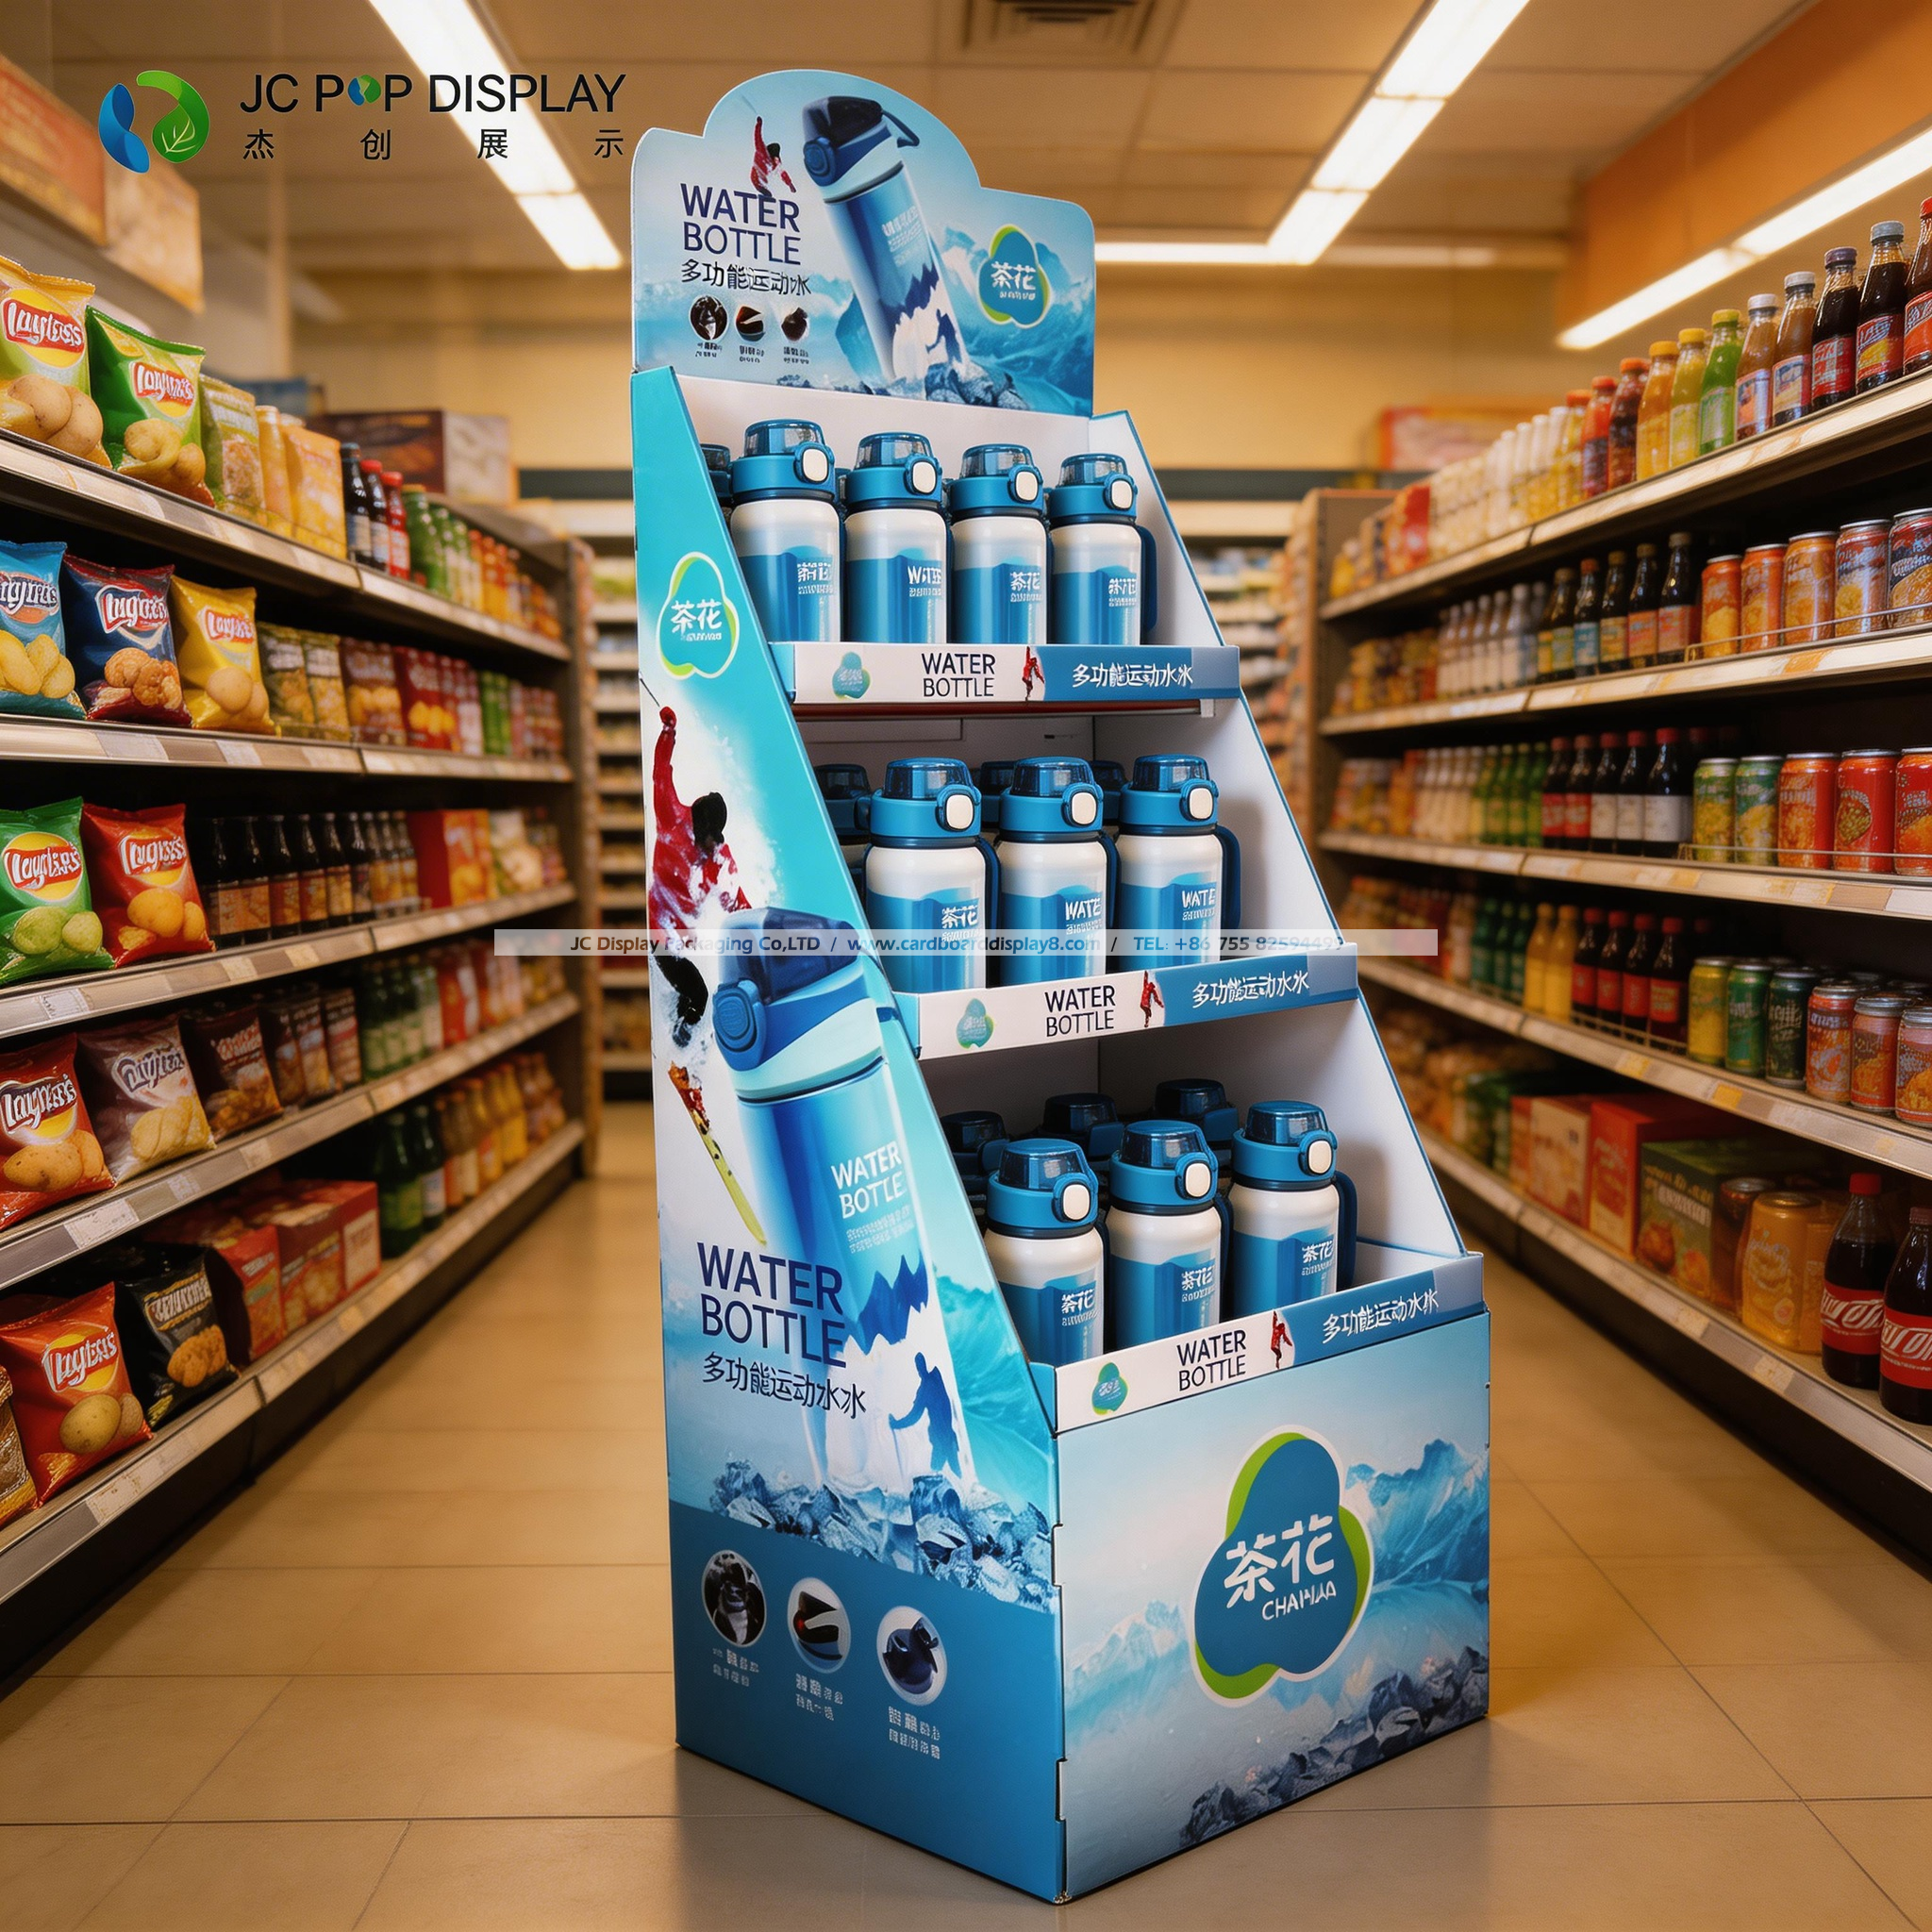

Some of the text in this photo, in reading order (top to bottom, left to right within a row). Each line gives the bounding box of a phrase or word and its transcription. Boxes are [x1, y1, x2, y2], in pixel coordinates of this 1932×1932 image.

[680, 183, 800, 232] WATER
[684, 222, 801, 265] BOTTLE
[991, 260, 1036, 291] 茶花
[671, 598, 722, 635] 茶花
[922, 653, 996, 675] WATER
[924, 677, 994, 698] BOTTLE
[1044, 985, 1116, 1012] WATER
[1046, 1009, 1114, 1037] BOTTLE
[831, 1141, 902, 1190] WATER
[696, 1241, 843, 1315] WATER
[701, 1293, 846, 1368] BOTTLE
[1176, 1329, 1246, 1366] WATER
[1179, 1355, 1246, 1391] BOTTLE
[1224, 1514, 1335, 1608] 茶花
